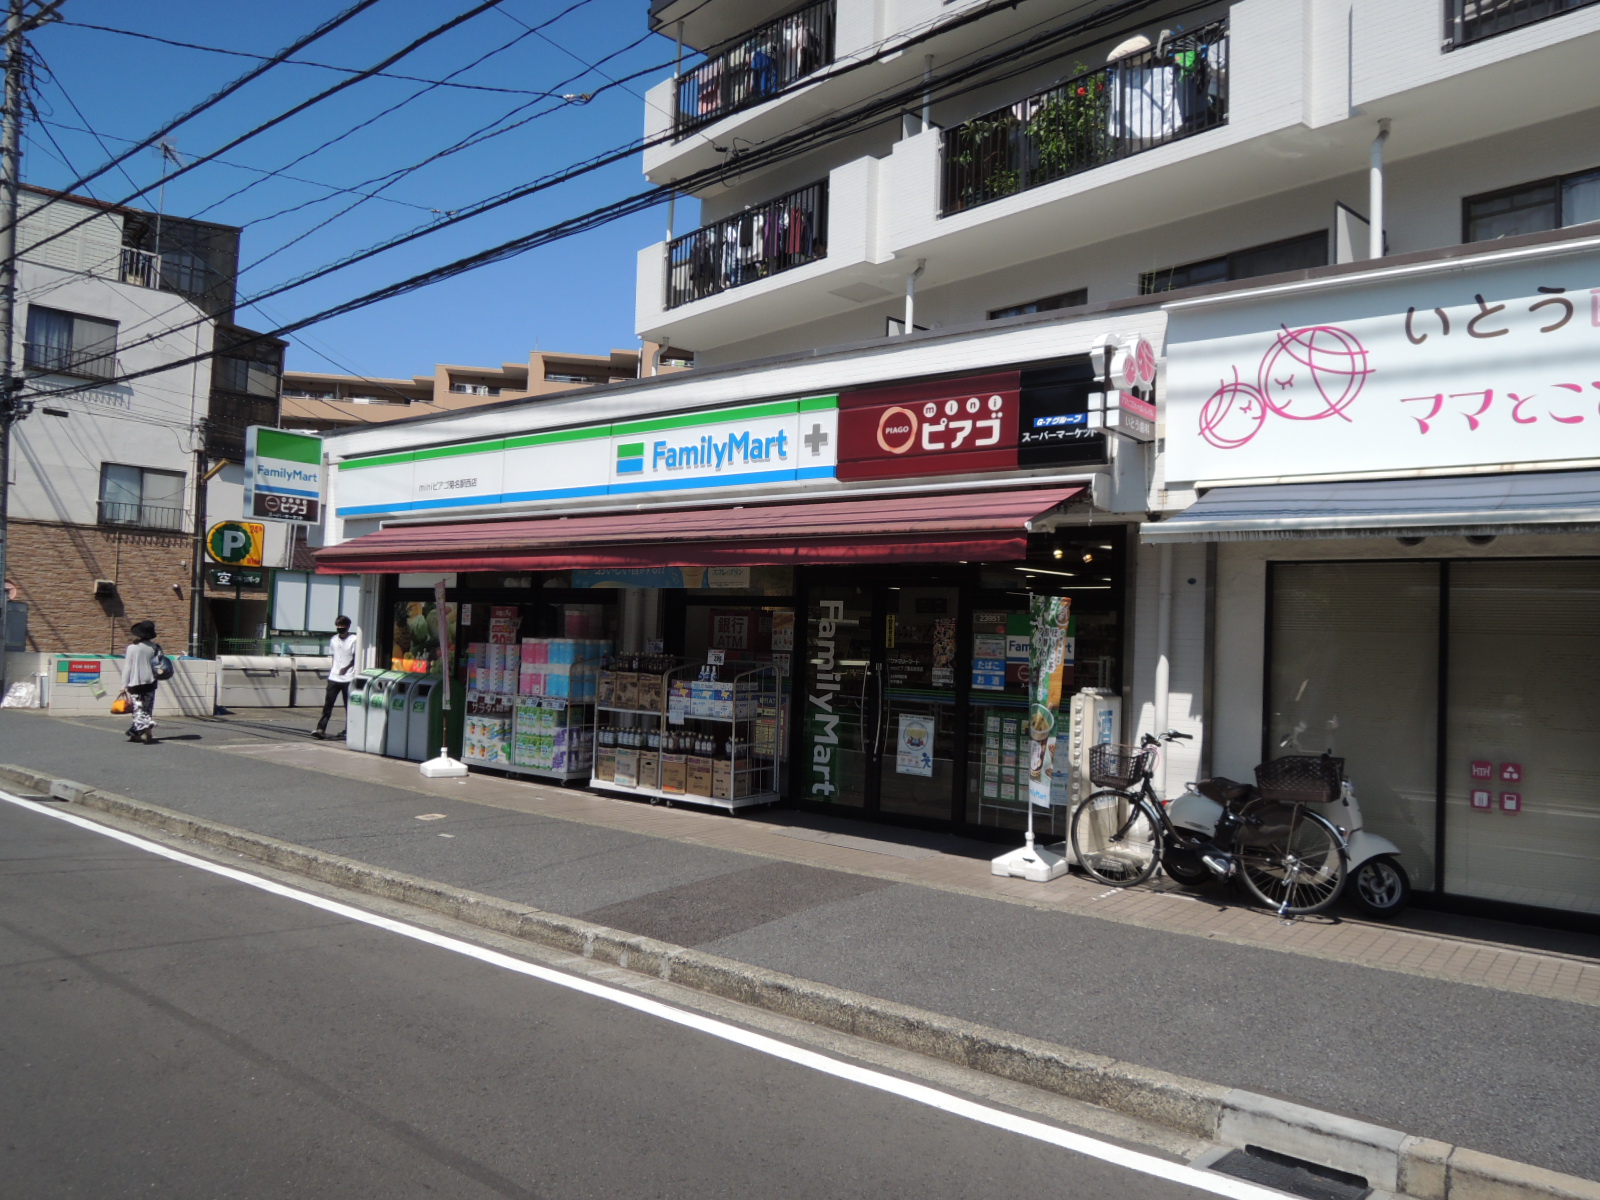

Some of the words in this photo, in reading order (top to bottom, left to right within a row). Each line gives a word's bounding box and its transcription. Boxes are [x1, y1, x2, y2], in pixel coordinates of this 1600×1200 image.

[885, 425, 909, 434] PIAGO
[922, 412, 1003, 450] ピアゴ
[1022, 428, 1097, 442] スーパーマーケット
[653, 429, 787, 470] FamilyMart
[257, 465, 318, 482] FamilyMart
[223, 530, 245, 557] P
[718, 616, 745, 633] 銀行
[717, 635, 743, 648] ATM
[977, 661, 1001, 670] たばこ
[809, 600, 844, 796] FamilyMart
